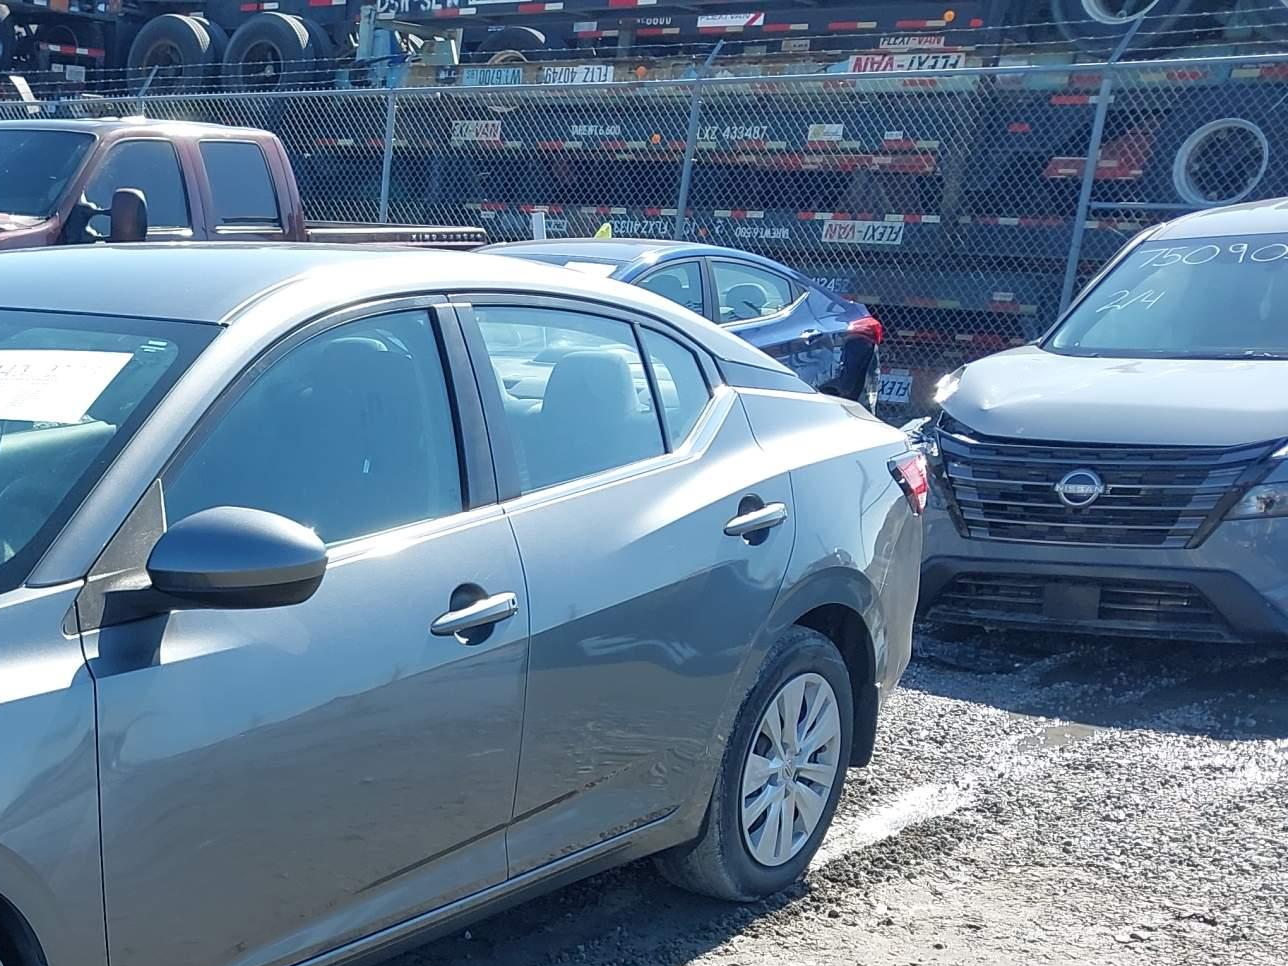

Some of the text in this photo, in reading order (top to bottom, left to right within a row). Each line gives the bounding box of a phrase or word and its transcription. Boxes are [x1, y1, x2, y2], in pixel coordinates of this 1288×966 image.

[696, 126, 718, 140] LXZ
[825, 223, 902, 241] FLEXI-VAN
[1054, 483, 1105, 494] NISSAN
